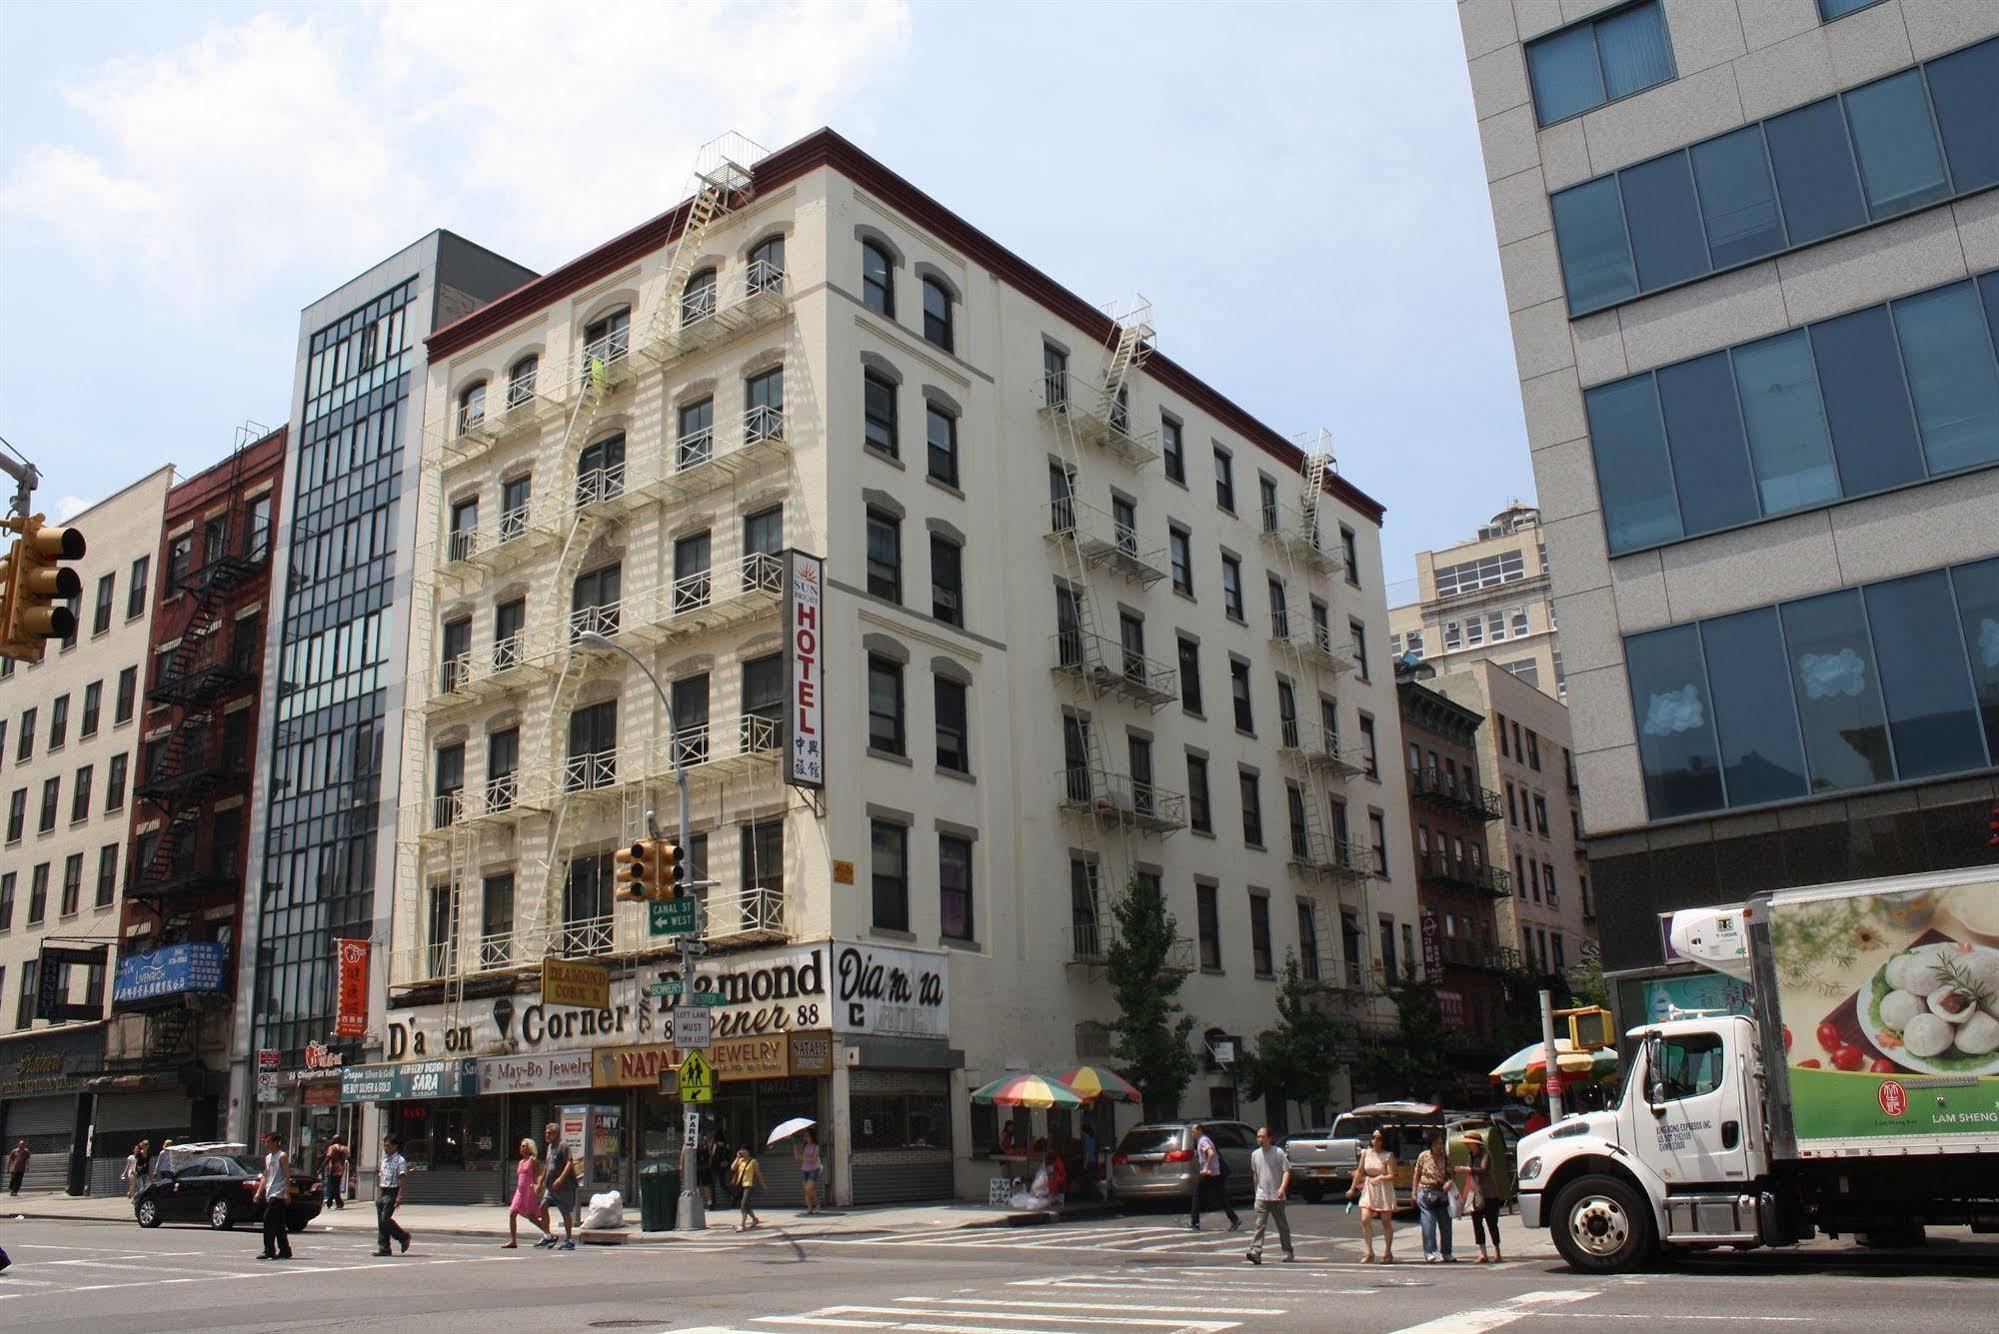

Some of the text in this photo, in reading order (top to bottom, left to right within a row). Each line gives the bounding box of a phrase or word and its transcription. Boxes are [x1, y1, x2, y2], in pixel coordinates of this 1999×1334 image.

[794, 579, 818, 596] SUN
[796, 602, 817, 735] HOTEL
[653, 901, 692, 915] CANAL ST
[671, 915, 692, 926] WEST
[551, 966, 608, 985] DIAMOND
[658, 950, 825, 1013] Damond
[651, 984, 682, 996] BOWERY
[797, 1003, 820, 1026] 88
[522, 1004, 630, 1046] Corner
[683, 1022, 702, 1031] MUST
[709, 1041, 781, 1064] JEWELRY
[793, 1040, 829, 1056] NATALIE
[343, 1068, 363, 1082] Dragon
[424, 1061, 444, 1073] DESIGN
[498, 1061, 543, 1081] May-Bo
[549, 1057, 593, 1079] Jewelry
[343, 1084, 350, 1094] WE
[350, 1083, 359, 1093] BUY
[359, 1082, 374, 1093] SILVER
[378, 1082, 391, 1092] GOLD
[412, 1073, 438, 1090] SARA
[1932, 1112, 1998, 1124] LAM SHENG
[688, 1114, 697, 1142] PARK
